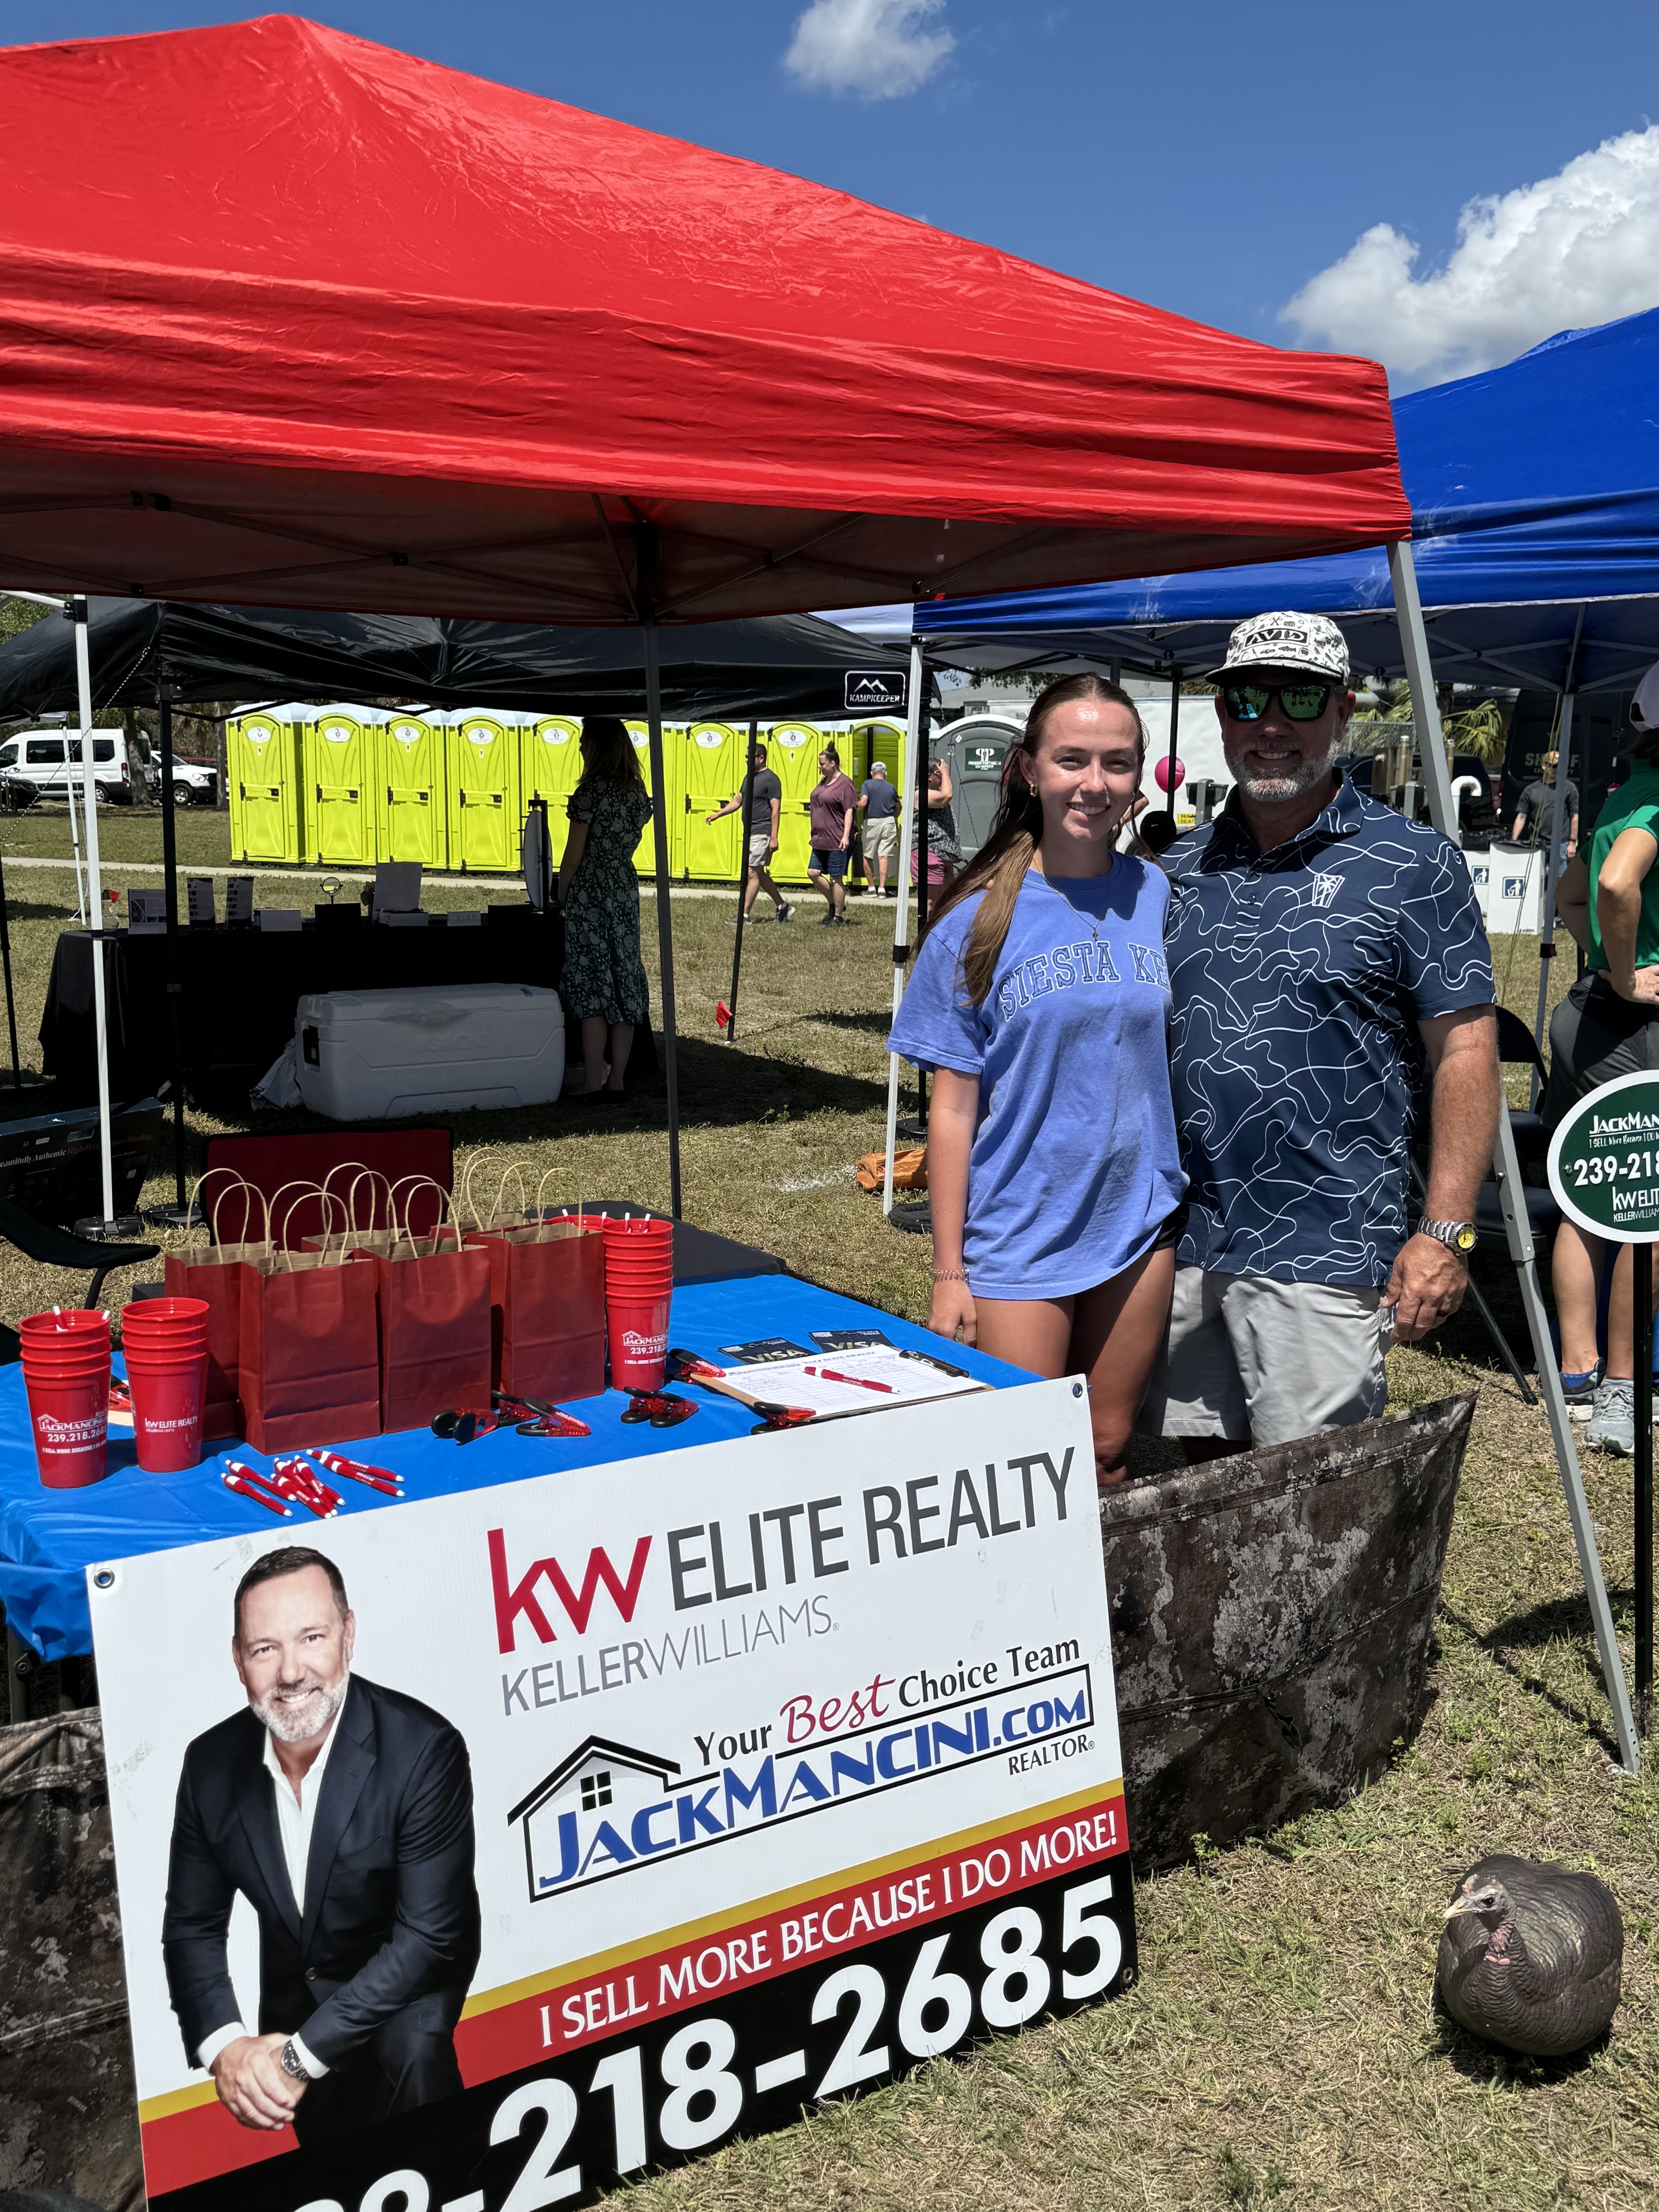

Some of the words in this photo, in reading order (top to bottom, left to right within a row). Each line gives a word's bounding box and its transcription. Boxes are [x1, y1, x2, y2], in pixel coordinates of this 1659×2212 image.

[1246, 629, 1305, 646] AVID
[850, 694, 900, 702] KAMPKEEPER
[998, 941, 1121, 1022] SIESTA
[1593, 1137, 1608, 1148] SELL
[0, 1156, 32, 1168] eautifully
[33, 1149, 66, 1162] Authentic
[742, 1349, 806, 1362] VISA
[159, 1420, 177, 1429] ELITE
[178, 1415, 198, 1427] REALTY
[488, 1528, 653, 1654] kw
[667, 1496, 849, 1611] ELITE
[862, 1446, 1075, 1565] REALTY
[694, 1724, 772, 1767] Your
[779, 1673, 896, 1744] Best
[898, 1659, 998, 1708] Choice
[1006, 1638, 1080, 1677] Team
[540, 2005, 553, 2048] I
[563, 1976, 649, 2040] SELL
[657, 1929, 772, 2005] MORE
[780, 1875, 935, 1962] BECAUSE
[941, 1866, 954, 1905] I
[959, 1848, 1011, 1899] DO
[1020, 1810, 1118, 1878] MORE!
[293, 1875, 1122, 2212] -218-2685
